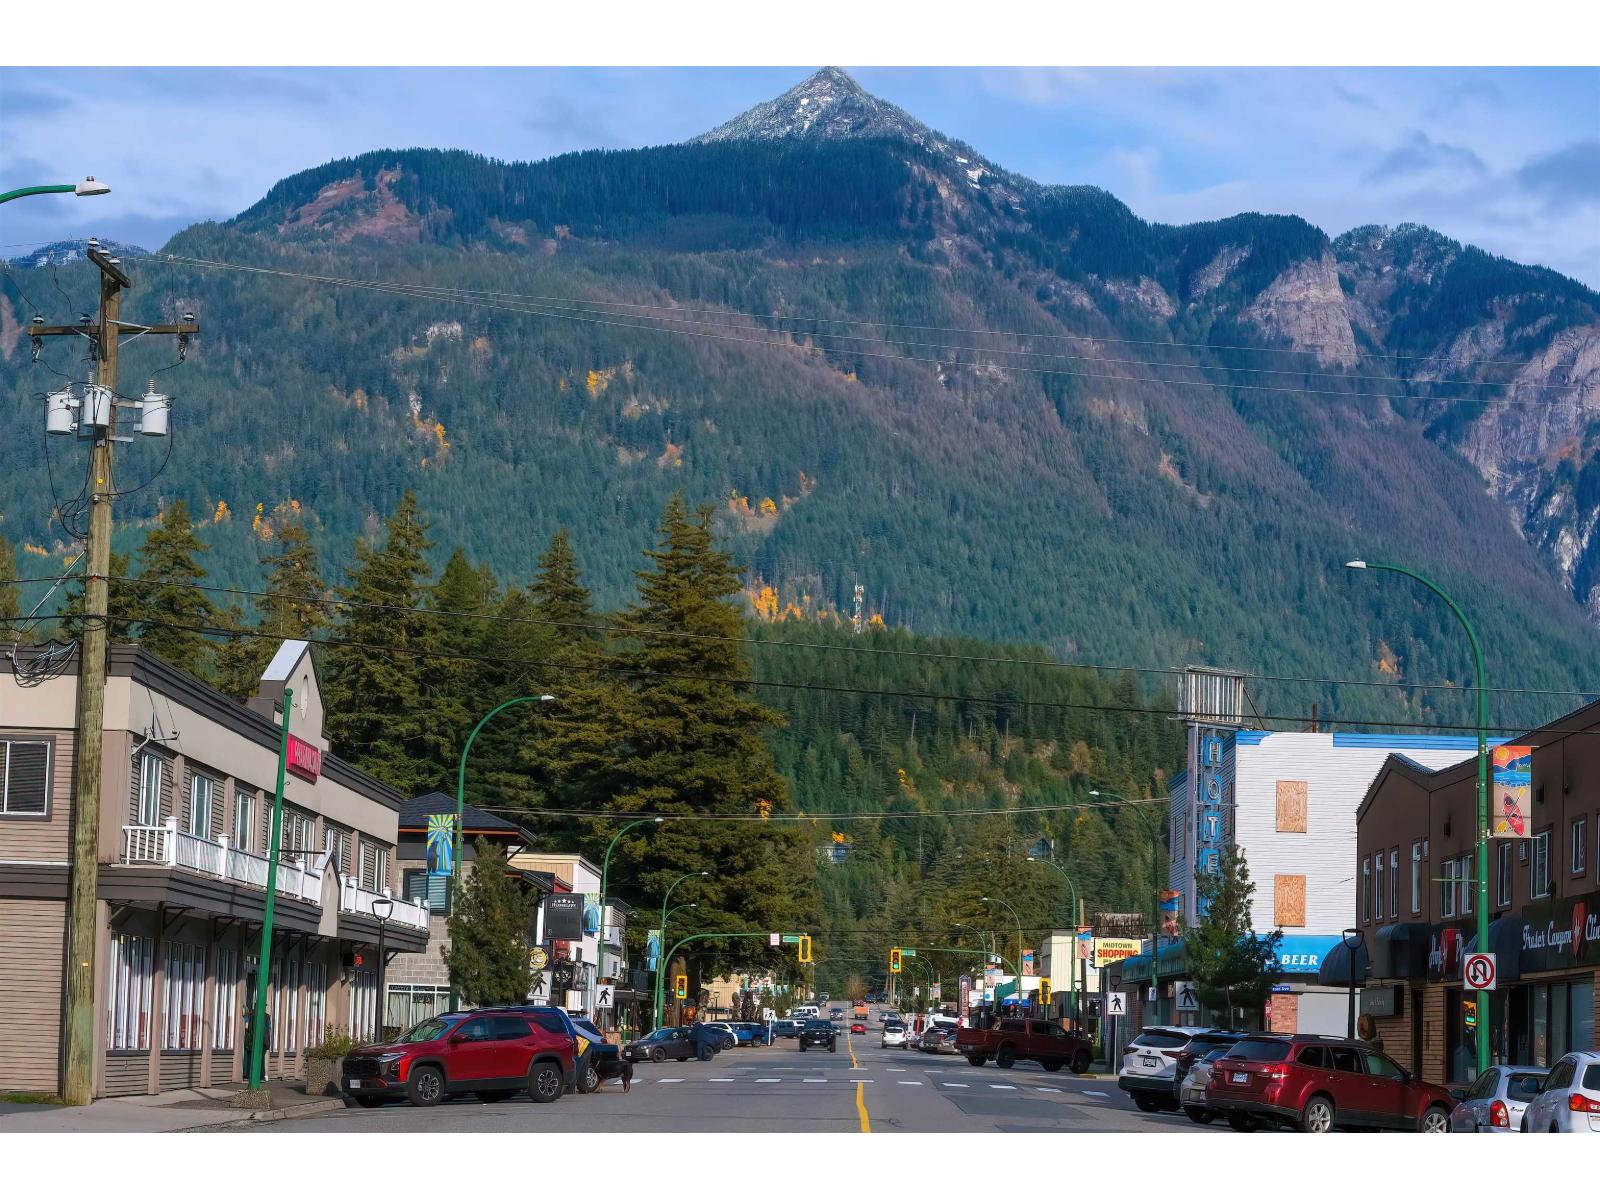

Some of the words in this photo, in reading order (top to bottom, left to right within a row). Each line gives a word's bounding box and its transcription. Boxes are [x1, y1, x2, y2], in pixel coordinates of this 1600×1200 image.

[1547, 920, 1573, 953] Canyon
[1097, 949, 1139, 959] SHOPPING
[1281, 954, 1319, 966] BEER
